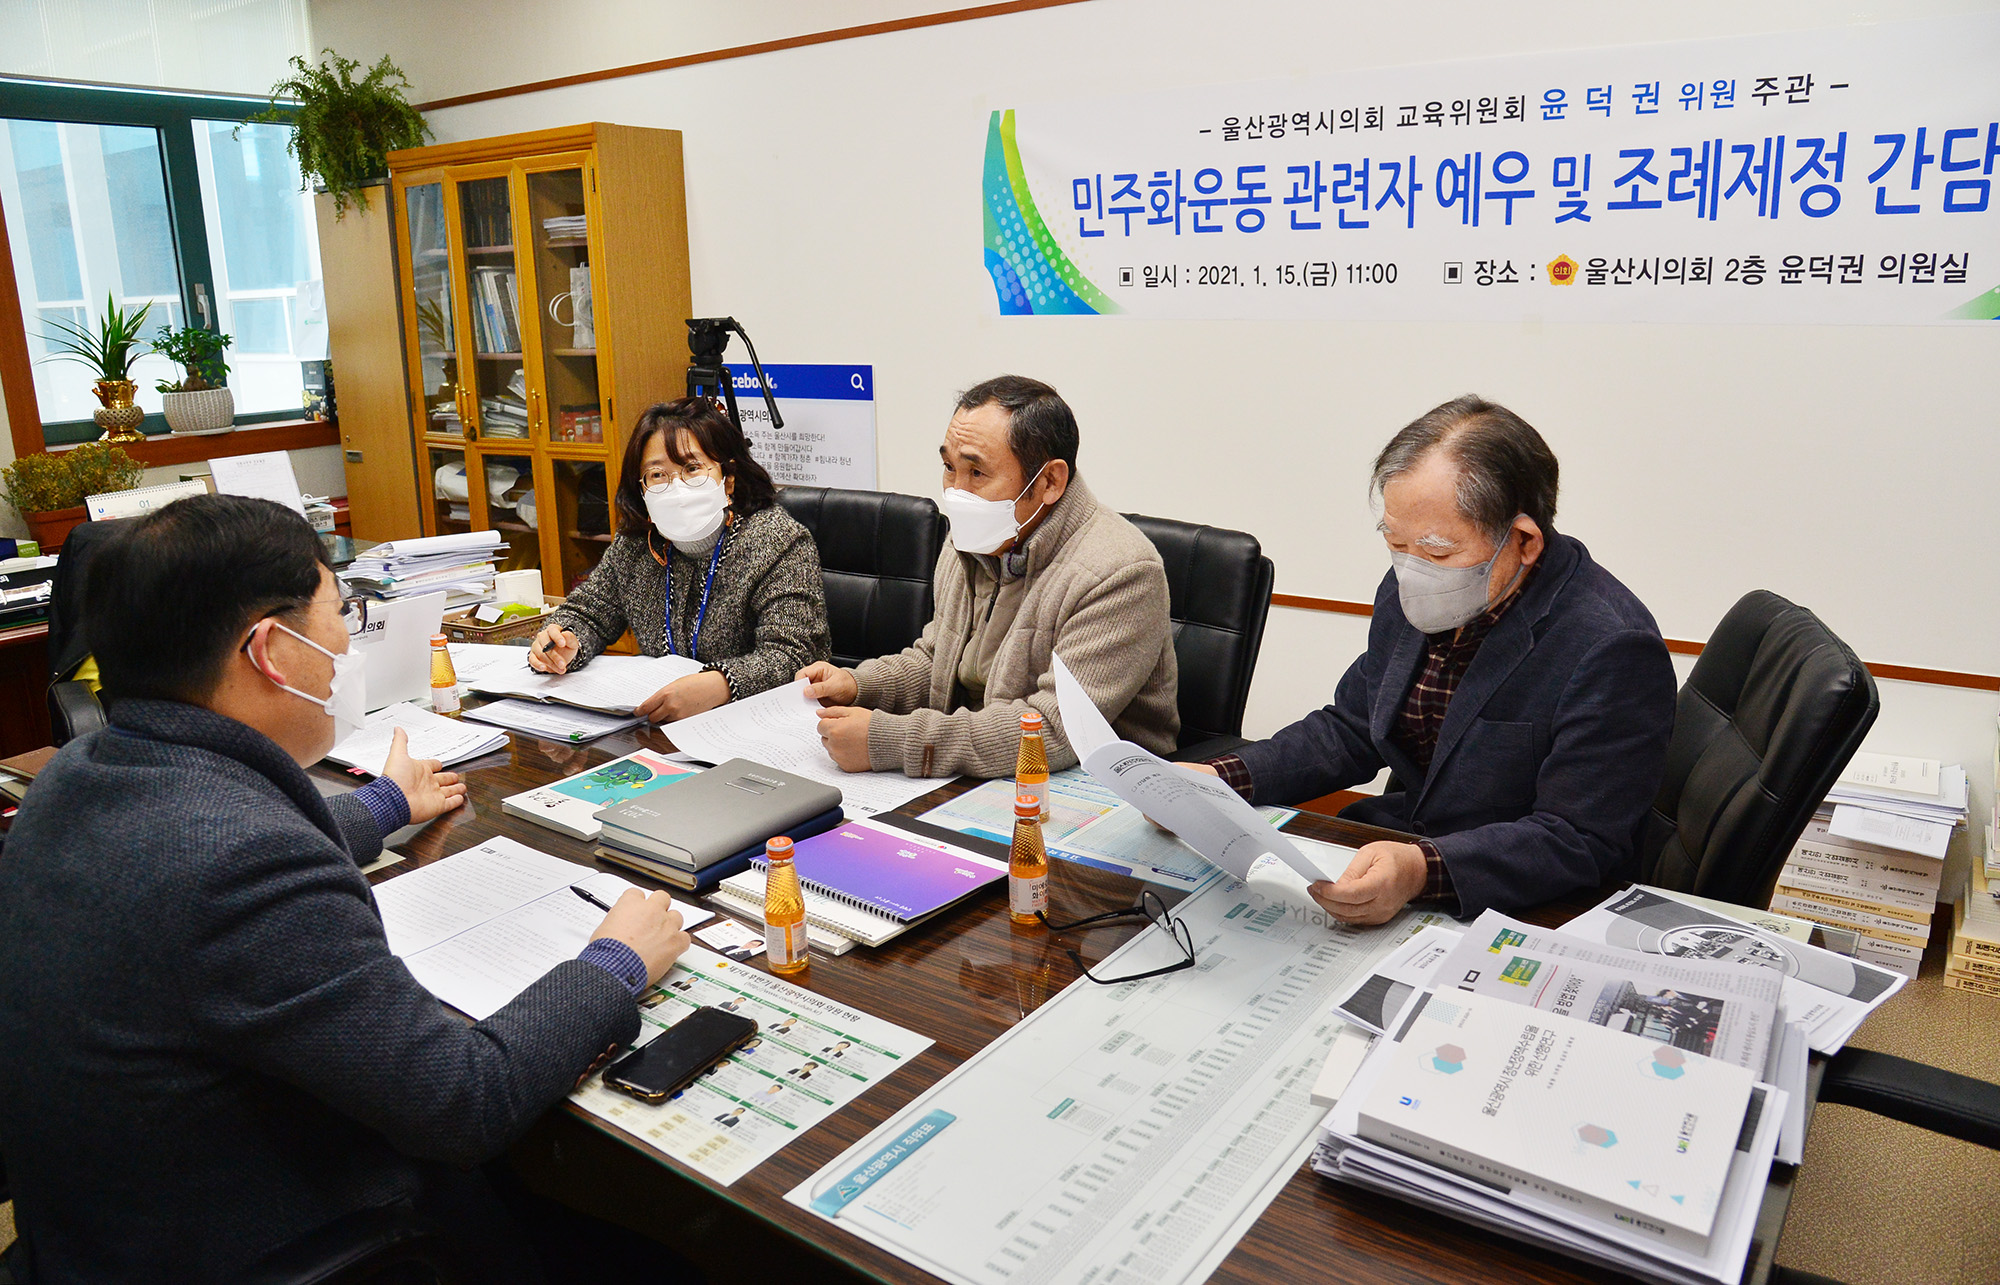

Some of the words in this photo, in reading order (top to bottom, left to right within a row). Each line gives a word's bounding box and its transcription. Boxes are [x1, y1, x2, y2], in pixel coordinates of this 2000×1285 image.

[1221, 104, 1385, 142] 울산광역시의회
[1396, 95, 1527, 129] 교육위원회
[1539, 88, 1569, 121] 윤
[1585, 84, 1613, 118] 덕
[1631, 81, 1661, 115] 권
[1678, 78, 1737, 111] 위원
[1751, 73, 1815, 106] 주관
[1072, 163, 1273, 238] 민주화운동
[1283, 155, 1423, 231] 관련자
[1435, 150, 1536, 228] 예우
[1552, 153, 1592, 225] 및
[1606, 130, 1848, 222] 조례제정
[1142, 264, 1179, 289] 일시
[1199, 265, 1246, 288] 2021.
[1253, 265, 1268, 287] 1.
[1276, 261, 1338, 288] 15.(금)
[1346, 262, 1398, 285] 11:00
[1474, 258, 1520, 285] 장소
[1585, 255, 1714, 287] 울산시의회
[1725, 255, 1768, 285] 2층
[1778, 254, 1865, 285] 윤덕권
[1877, 252, 1970, 285] 의원실
[721, 372, 774, 389] cebok
[853, 1143, 907, 1185] 울산광역시
[902, 1121, 935, 1150] 직위표
